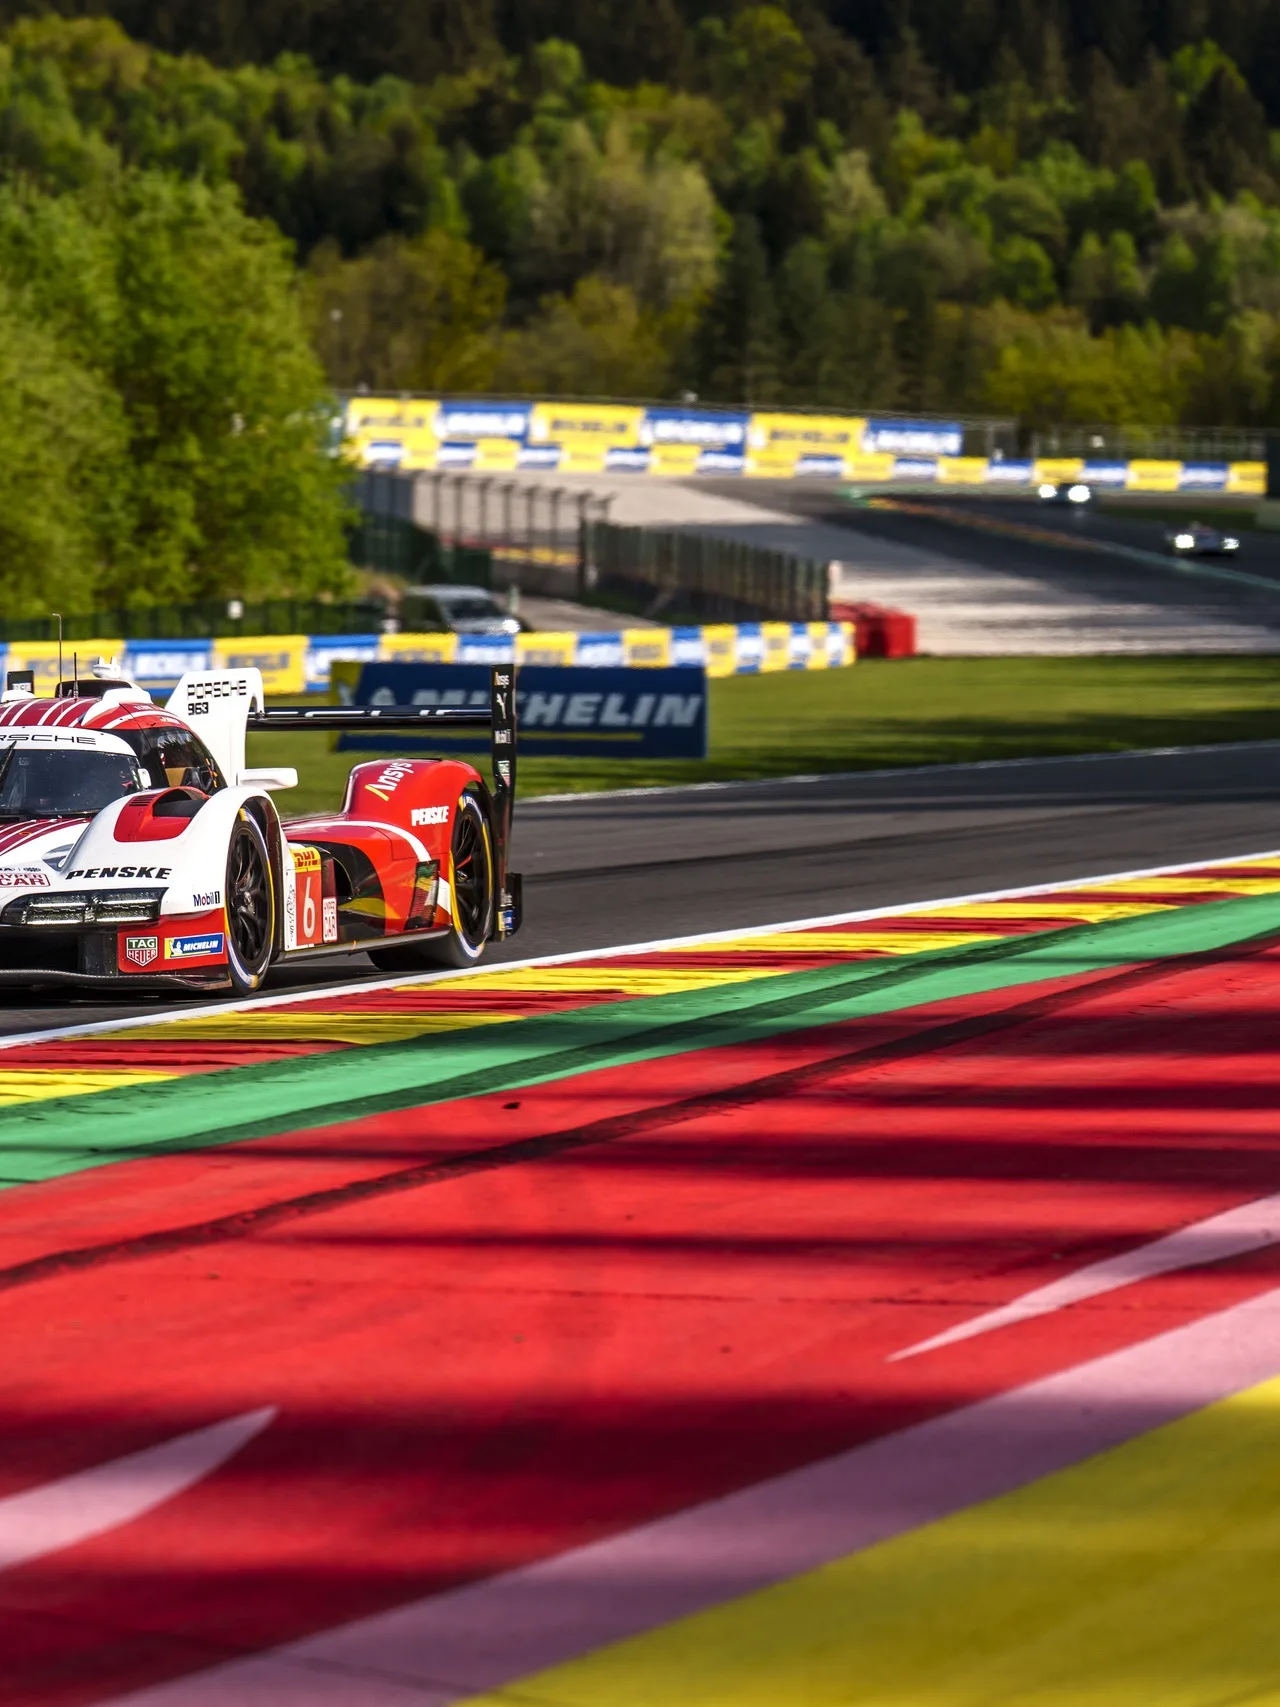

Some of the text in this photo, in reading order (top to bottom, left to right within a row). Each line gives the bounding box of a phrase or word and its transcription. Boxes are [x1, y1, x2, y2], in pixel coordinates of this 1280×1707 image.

[187, 680, 246, 699] PORSCHE
[188, 702, 209, 716] 963
[411, 688, 703, 728] HELIN
[364, 761, 415, 802] Ansys
[411, 805, 450, 827] PENSKE
[65, 866, 173, 880] PENSKE
[193, 892, 214, 907] Mobil
[303, 876, 316, 938] 6
[129, 939, 155, 948] TAG
[183, 940, 219, 952] MICHELIN
[128, 949, 156, 964] HEUER
